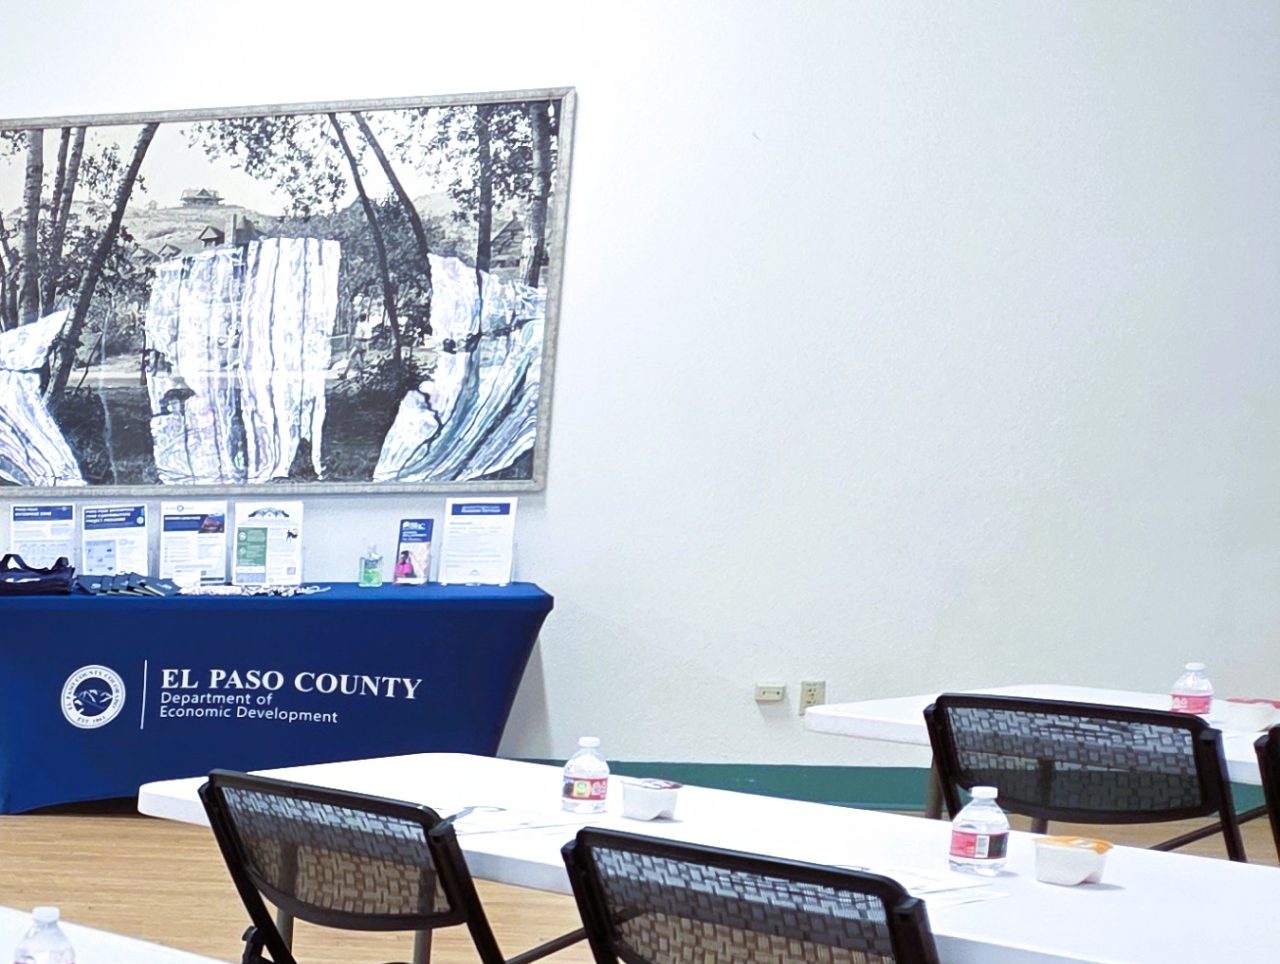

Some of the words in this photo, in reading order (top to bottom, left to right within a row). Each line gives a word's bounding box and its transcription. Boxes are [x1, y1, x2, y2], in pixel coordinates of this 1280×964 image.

[160, 668, 199, 690] EL
[208, 669, 285, 691] PASO
[293, 671, 423, 700] COUNTY
[160, 691, 251, 705] Department
[256, 692, 273, 706] of
[159, 705, 232, 718] Economic
[235, 705, 339, 724] Development
